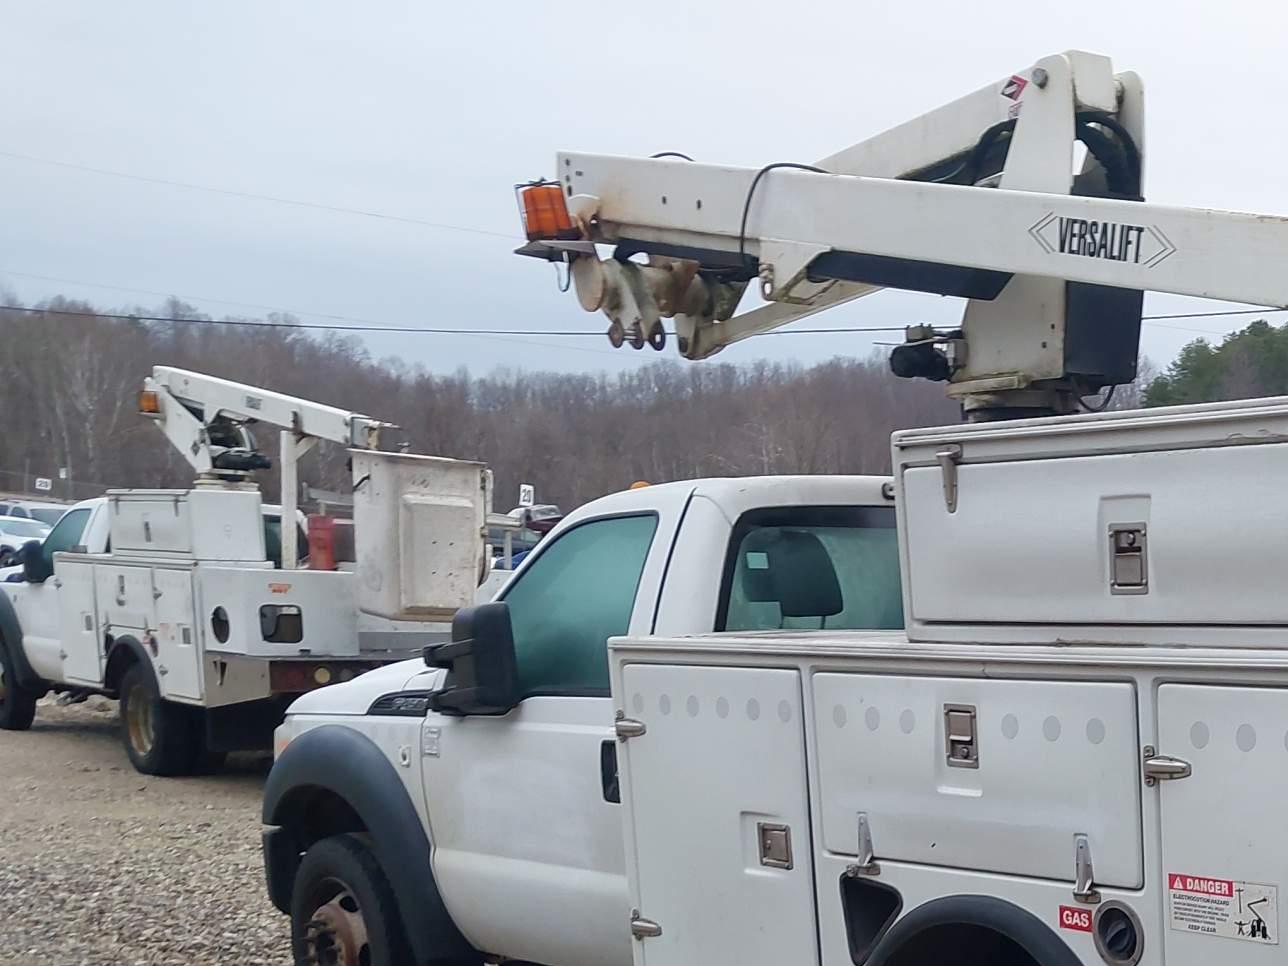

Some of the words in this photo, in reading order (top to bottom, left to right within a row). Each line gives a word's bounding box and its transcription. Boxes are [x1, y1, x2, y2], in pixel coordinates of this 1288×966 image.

[1058, 216, 1145, 263] VERSALIFT
[1186, 878, 1229, 895] DANGER
[1062, 910, 1090, 928] GAS
